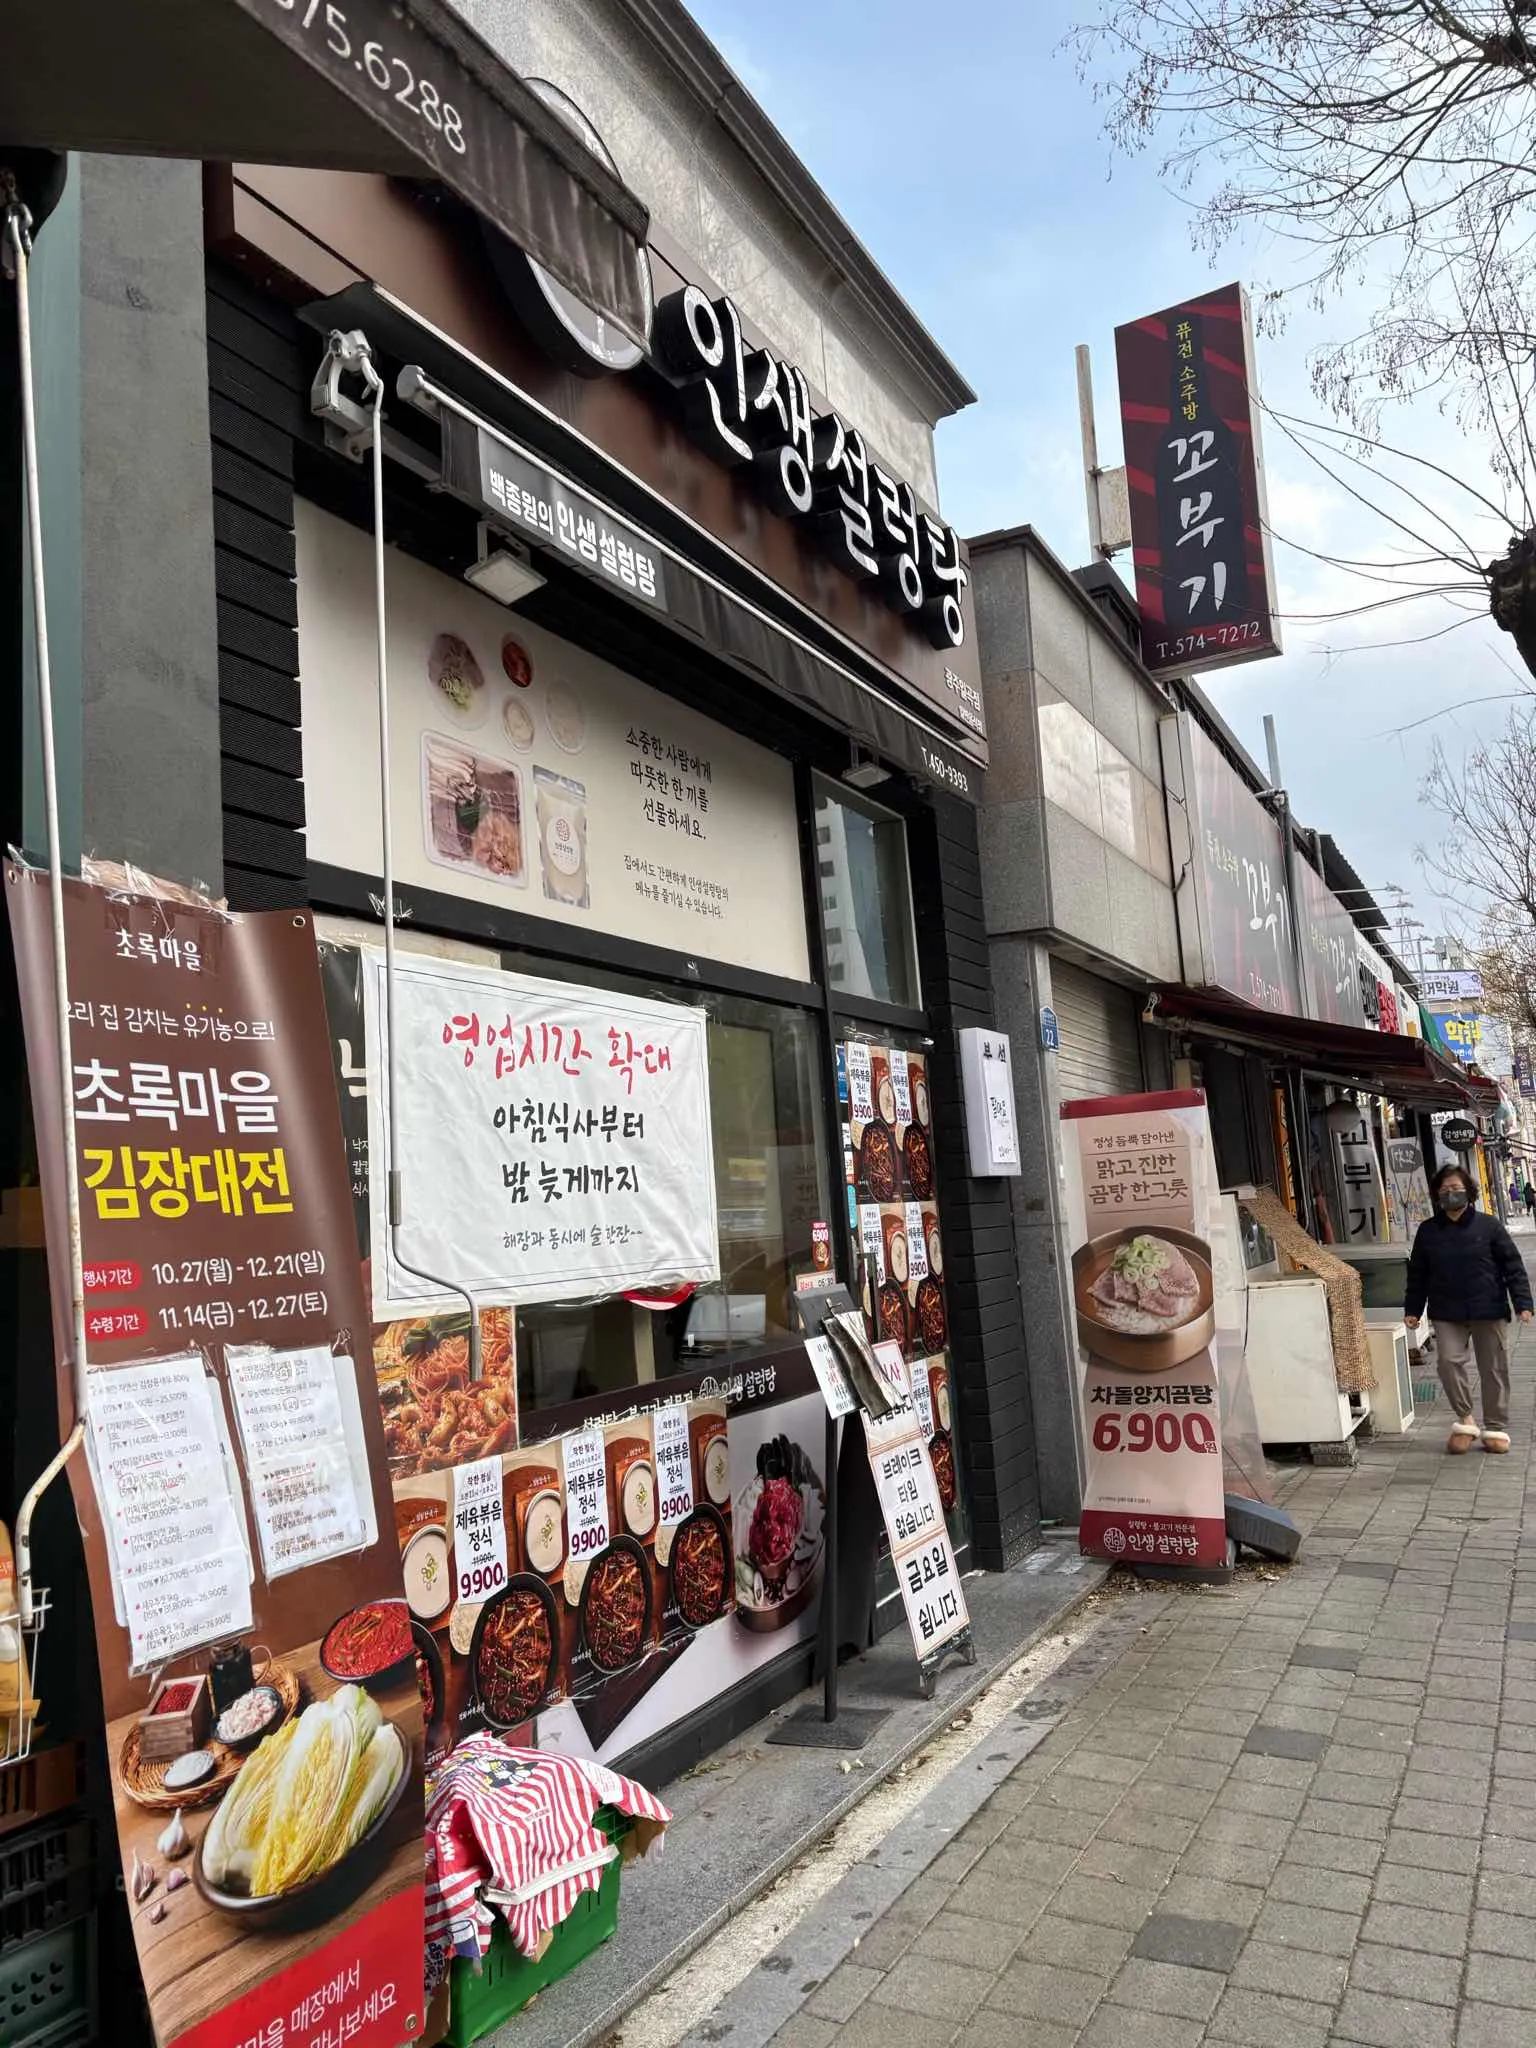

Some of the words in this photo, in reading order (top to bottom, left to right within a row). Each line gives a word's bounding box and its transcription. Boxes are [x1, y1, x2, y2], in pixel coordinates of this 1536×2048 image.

[276, 0, 466, 153] 5.6288
[1175, 321, 1194, 358] 퓨전
[1179, 366, 1199, 421] 소주방
[489, 468, 555, 536] 백종원의
[1167, 430, 1228, 615] 꼬부기
[1157, 621, 1262, 659] T.574-7272
[626, 727, 663, 760] 소중한
[666, 744, 712, 783] 사람에게
[921, 746, 968, 792] T.450-9393
[630, 761, 669, 795] 따뜻한
[672, 779, 683, 801] 한
[687, 786, 708, 812] 끼를
[643, 797, 706, 839] 선물하세요.
[635, 881, 660, 900] 메뉴를
[115, 928, 201, 971] 초록마을
[99, 1003, 119, 1031] 집
[124, 1006, 179, 1036] 김치는
[184, 1014, 276, 1041] 유기농으로!
[442, 1012, 592, 1080] 영업시간
[608, 1026, 672, 1094] 확대
[74, 1059, 279, 1133] 초록마을
[493, 1098, 644, 1143] 아침식사부터
[1093, 1136, 1113, 1149] 정성
[1140, 1131, 1175, 1145] 담아낸
[84, 1146, 294, 1219] 김장대전
[502, 1162, 530, 1203] 밤
[537, 1161, 640, 1203] 늦게까지
[1097, 1159, 1137, 1179] 맑고
[1138, 1153, 1176, 1176] 진한
[1088, 1183, 1128, 1205] 곰탕
[502, 1228, 544, 1251] 해장과
[549, 1228, 586, 1250] 동시에
[590, 1225, 602, 1245] 술
[83, 1269, 107, 1287] 행사
[109, 1268, 132, 1284] 기간
[89, 1316, 114, 1334] 수령
[115, 1314, 139, 1330] 기간
[1091, 1385, 1213, 1405] 차돌양지곰탕
[657, 1442, 688, 1464] 제육볶음
[882, 1448, 922, 1479] 브레이크
[568, 1469, 605, 1495] 제육볶음
[667, 1463, 683, 1483] 정식
[897, 1477, 919, 1503] 타임
[456, 1500, 502, 1530] 제육볶음
[579, 1492, 597, 1514] 정식
[895, 1503, 935, 1540] 없습니다
[469, 1526, 493, 1551] 정식
[906, 1542, 949, 1594] 금요일
[291, 1959, 360, 2031] 매장에서
